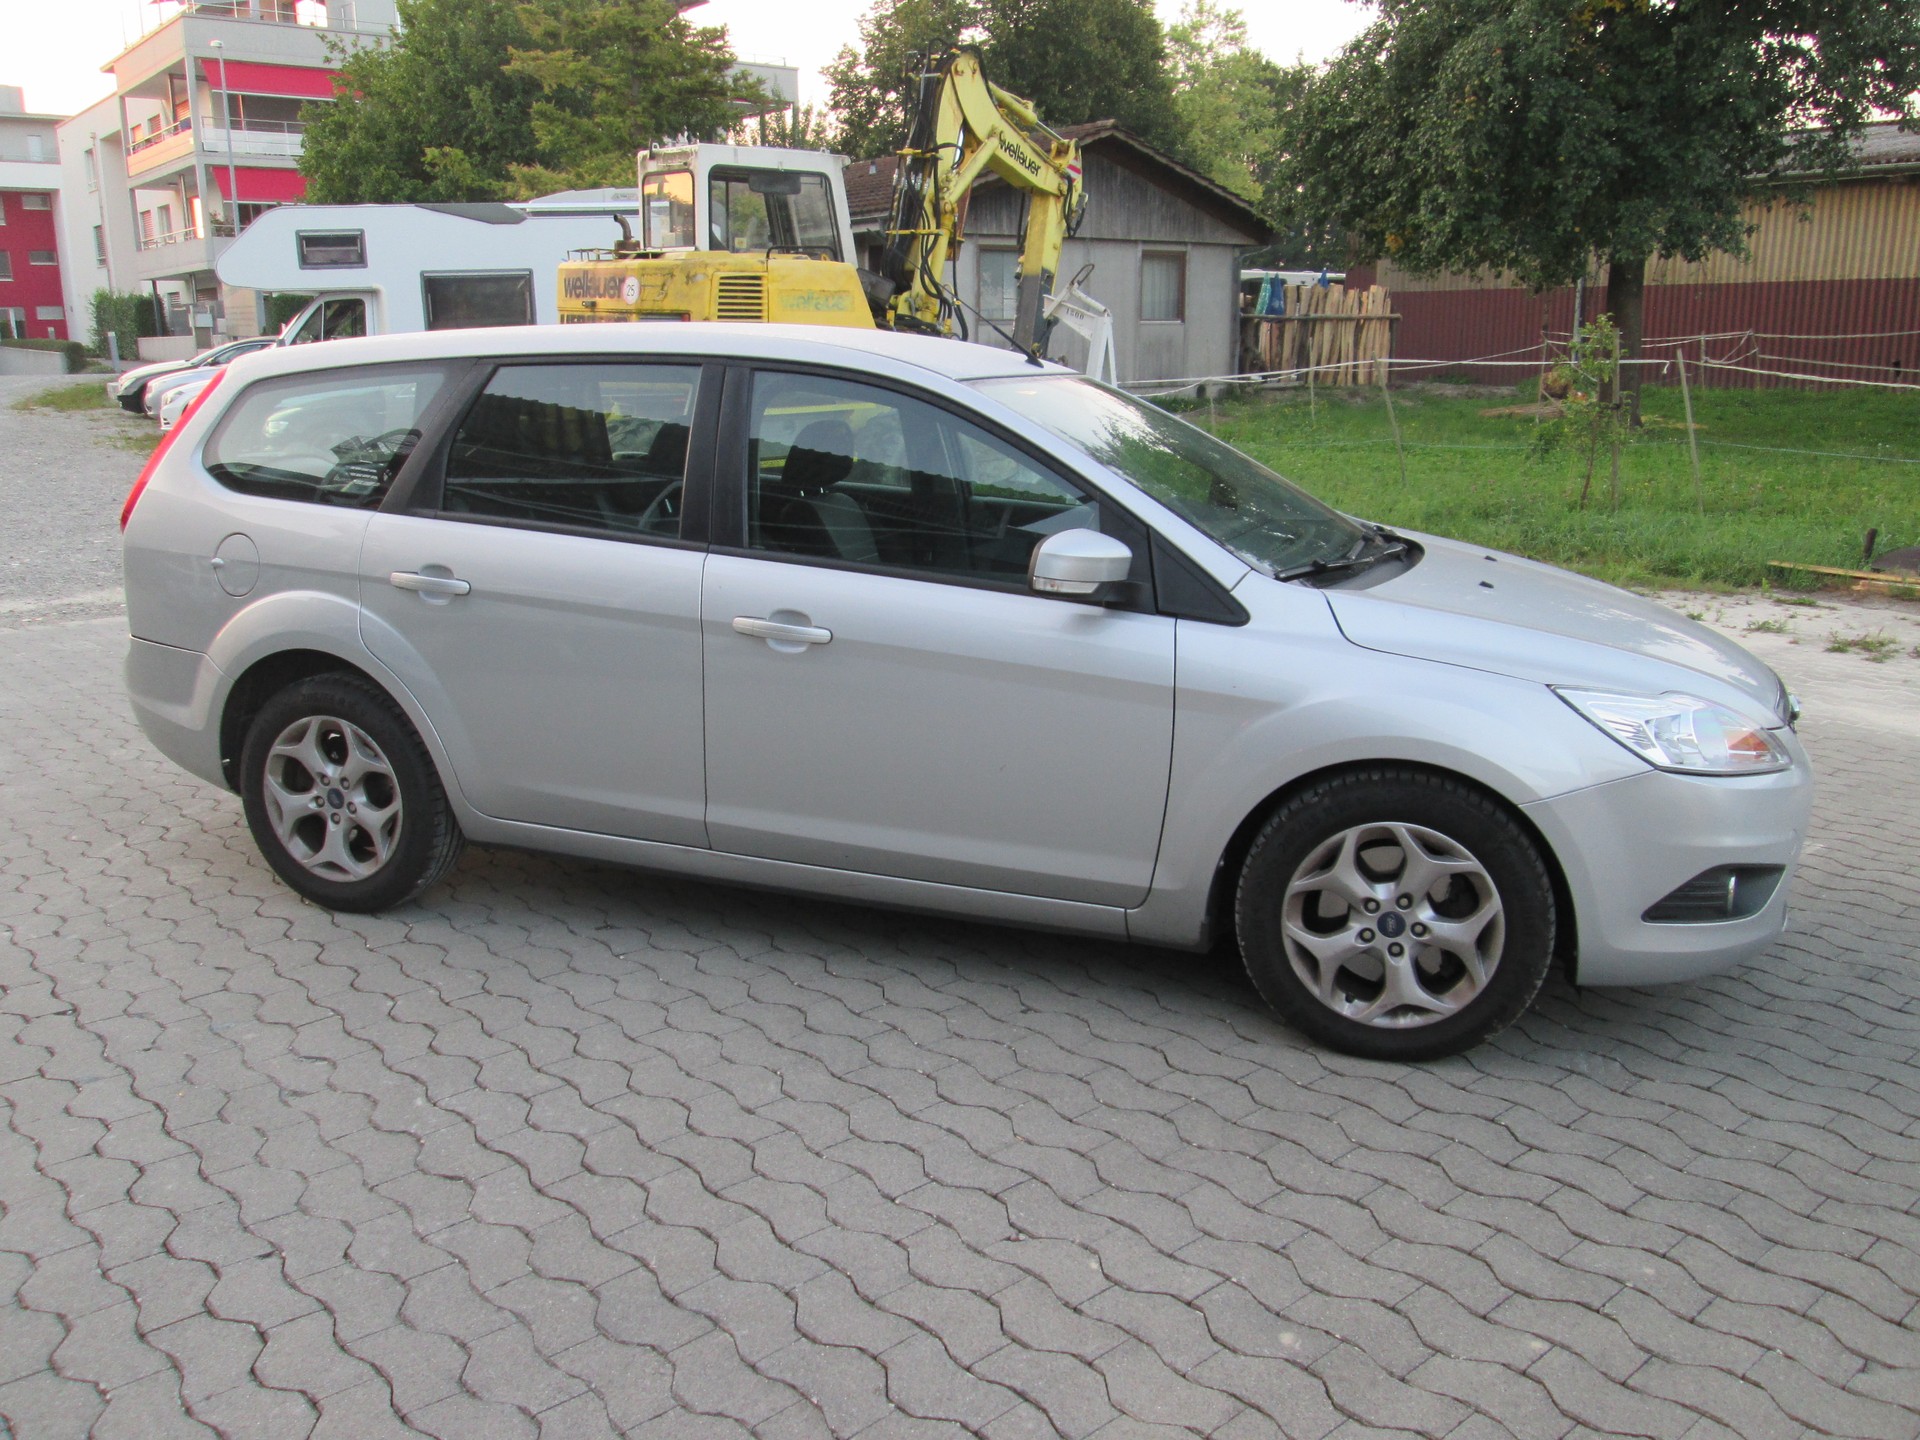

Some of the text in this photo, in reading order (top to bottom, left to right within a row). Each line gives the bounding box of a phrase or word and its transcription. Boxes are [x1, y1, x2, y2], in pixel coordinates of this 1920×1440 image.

[998, 138, 1041, 177] wellauer
[563, 270, 626, 299] wellauer
[626, 284, 635, 297] 25
